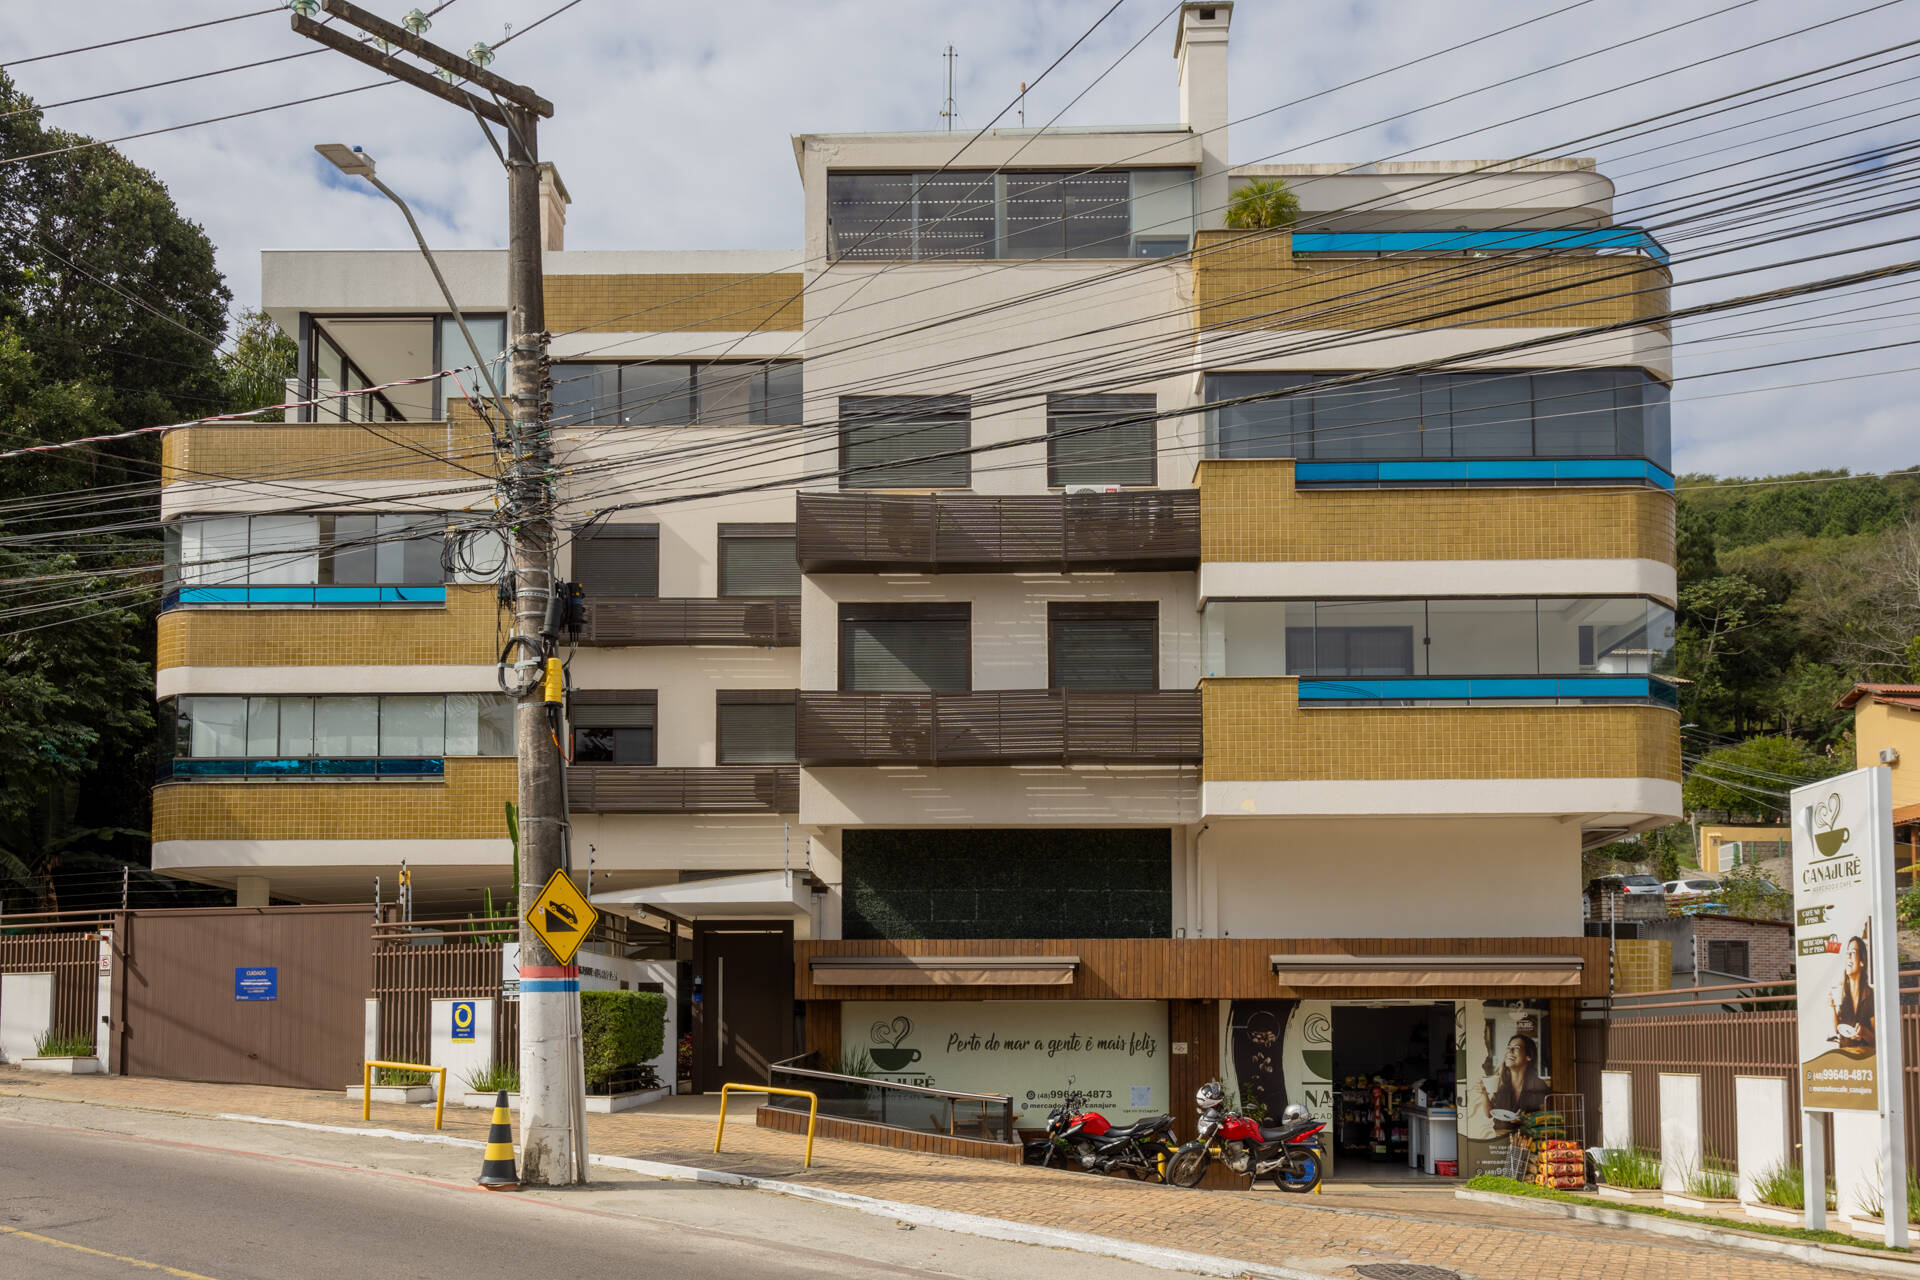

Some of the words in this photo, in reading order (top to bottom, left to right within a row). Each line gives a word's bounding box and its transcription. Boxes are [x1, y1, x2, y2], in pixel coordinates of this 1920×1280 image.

[1802, 856, 1861, 885] CANAJURÊ
[946, 1032, 982, 1053] Perto
[984, 1032, 1000, 1051] do
[1003, 1039, 1030, 1051] mar
[1034, 1039, 1043, 1050] a
[1047, 1032, 1082, 1058] gente
[1085, 1036, 1094, 1051] é
[1097, 1035, 1125, 1051] mais
[1129, 1032, 1157, 1058] feliz
